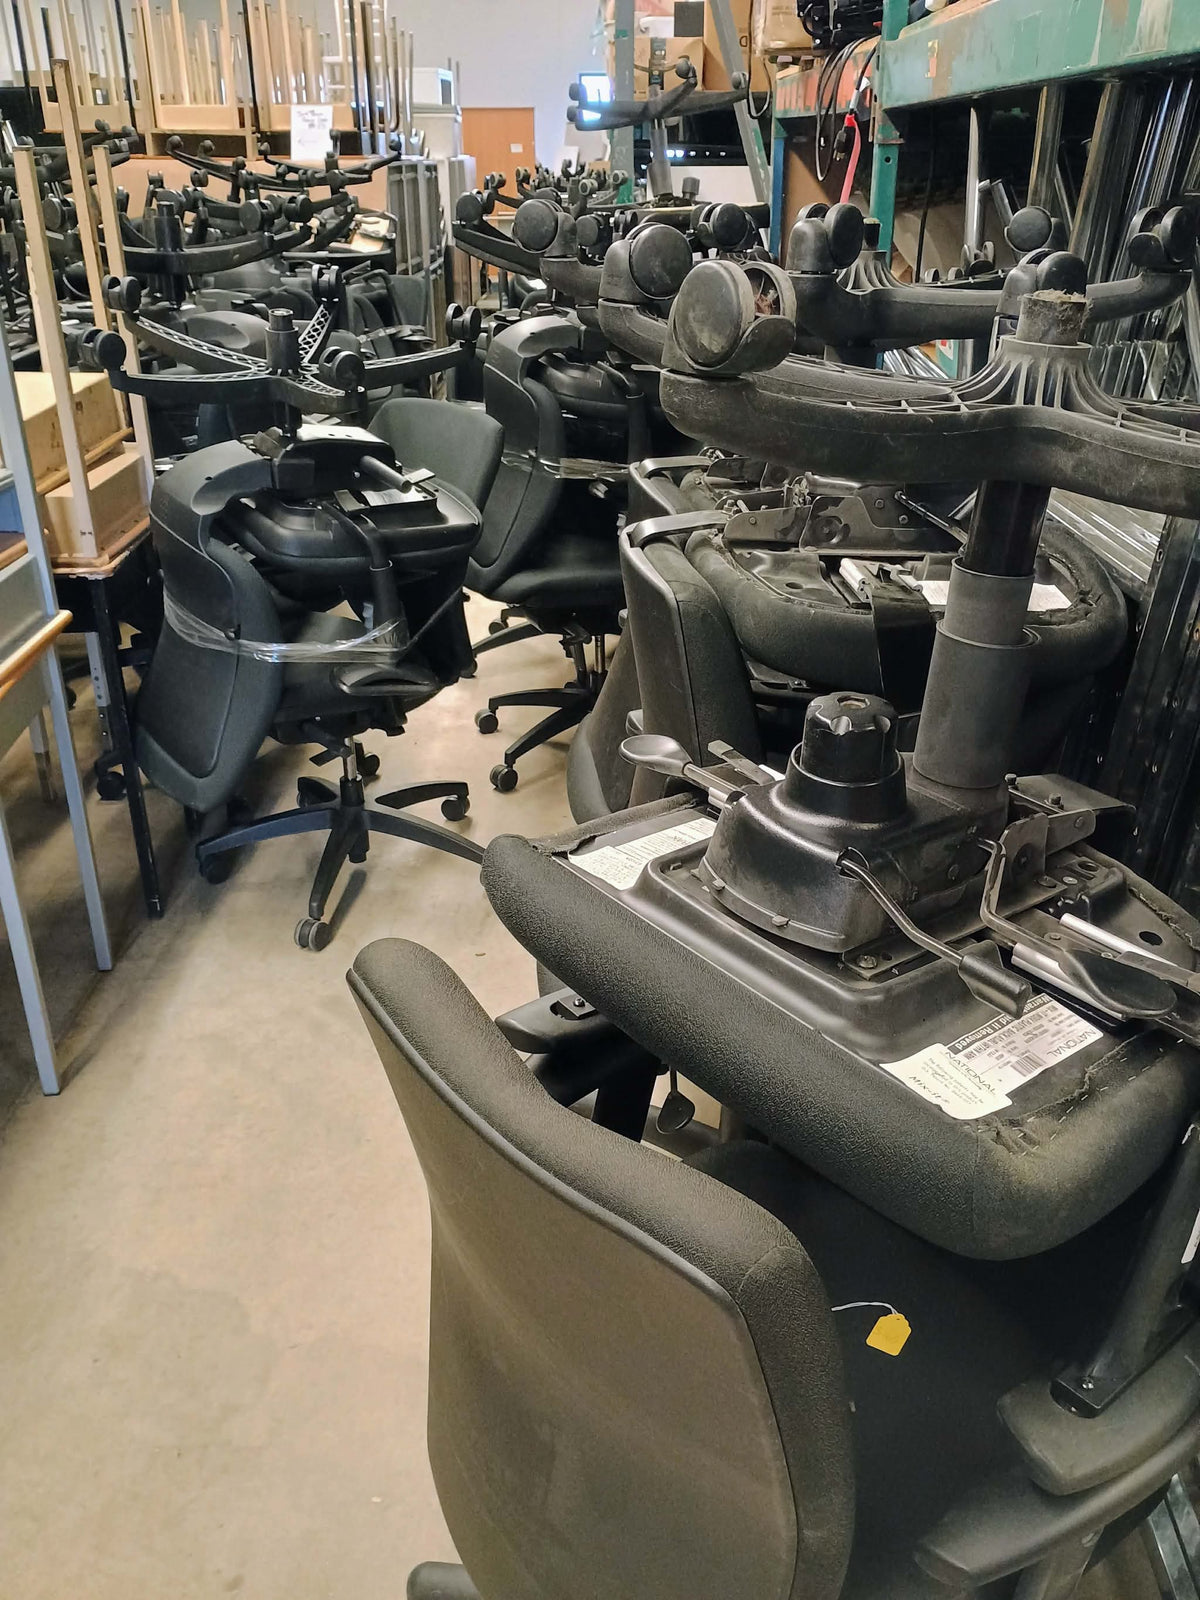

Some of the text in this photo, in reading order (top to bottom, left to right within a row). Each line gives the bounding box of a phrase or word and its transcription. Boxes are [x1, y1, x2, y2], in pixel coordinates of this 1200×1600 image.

[956, 1027, 993, 1051] Removed
[1046, 1028, 1097, 1059] NATIONAL
[945, 1050, 997, 1094] NATIONAL
